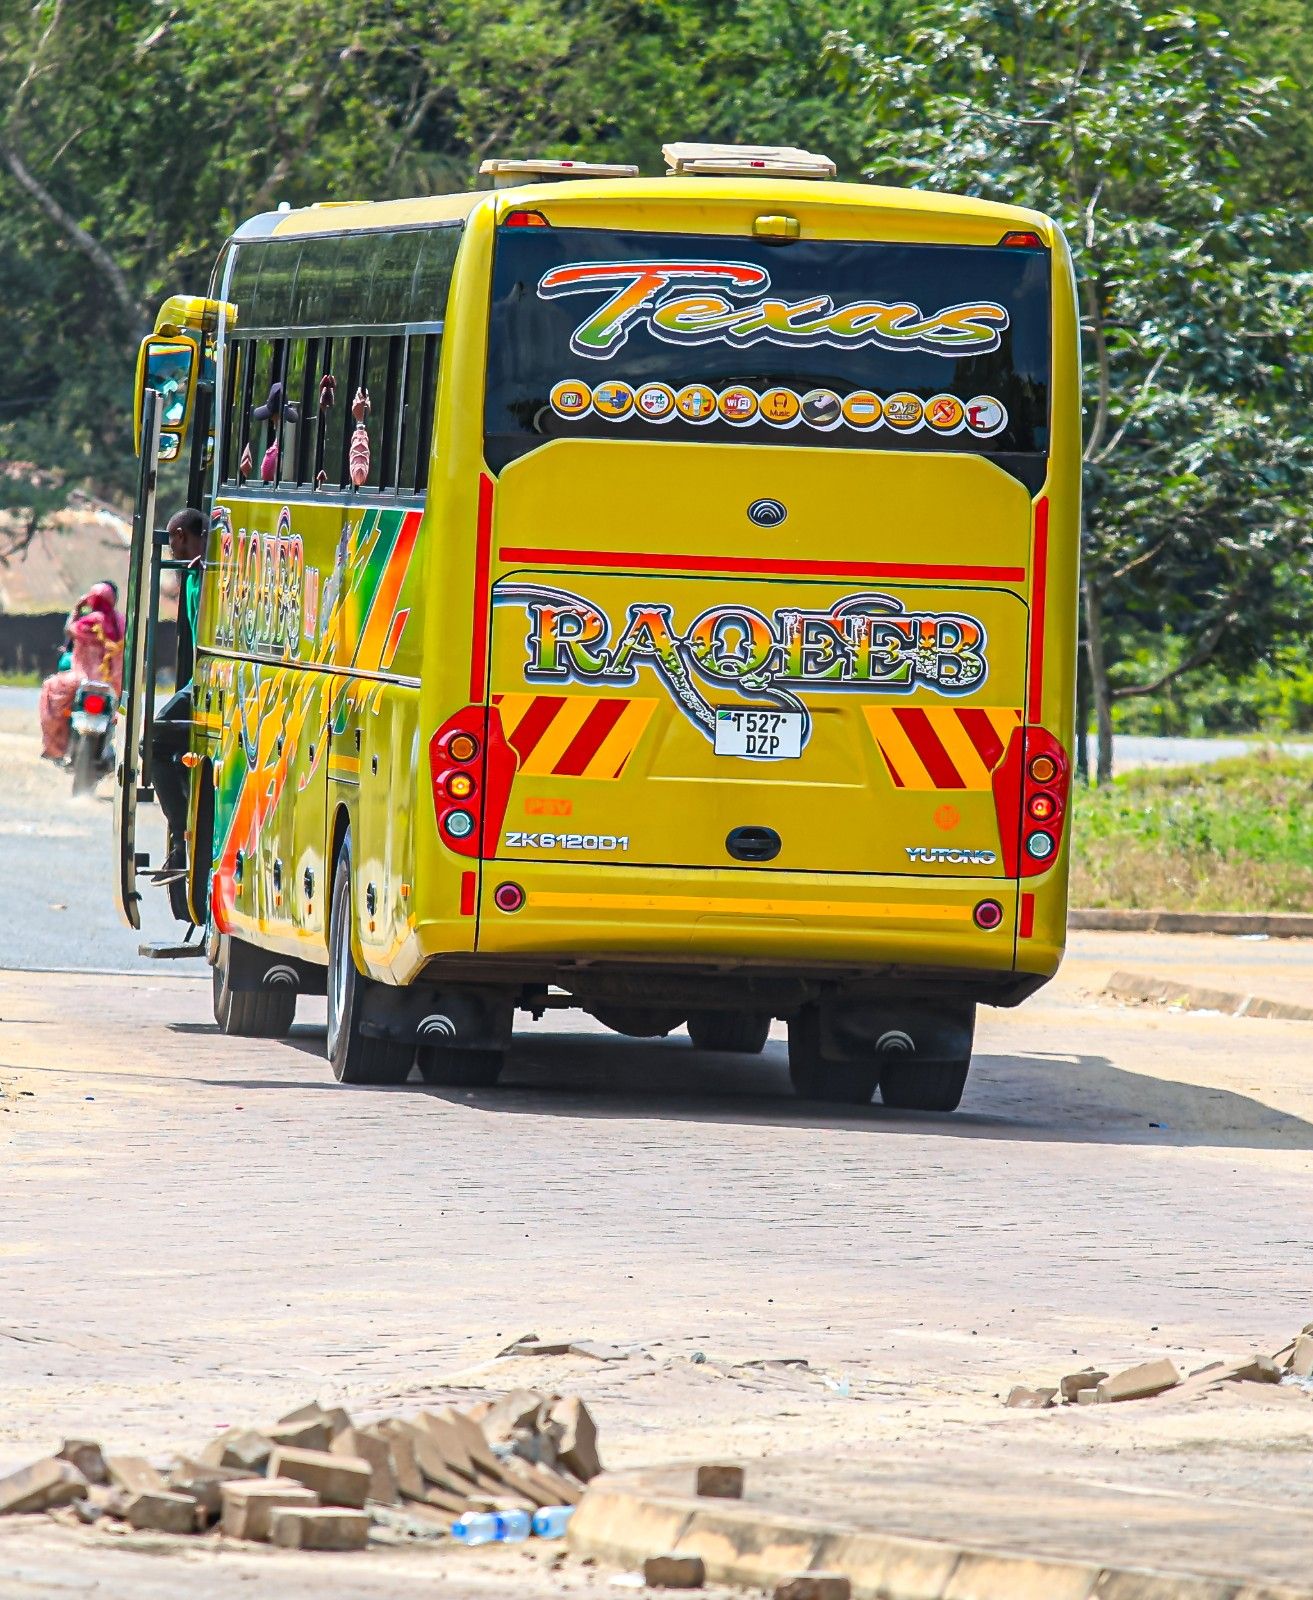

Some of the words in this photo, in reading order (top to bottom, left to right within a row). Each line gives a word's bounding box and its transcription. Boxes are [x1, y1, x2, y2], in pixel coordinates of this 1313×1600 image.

[537, 259, 1010, 360] Texas
[563, 394, 577, 404] TV
[889, 401, 919, 414] DVD
[769, 409, 790, 417] Music
[510, 592, 990, 715] RAQEEB
[746, 735, 780, 754] DZP
[505, 832, 629, 851] ZK6120D1
[905, 847, 997, 865] YUTONG
